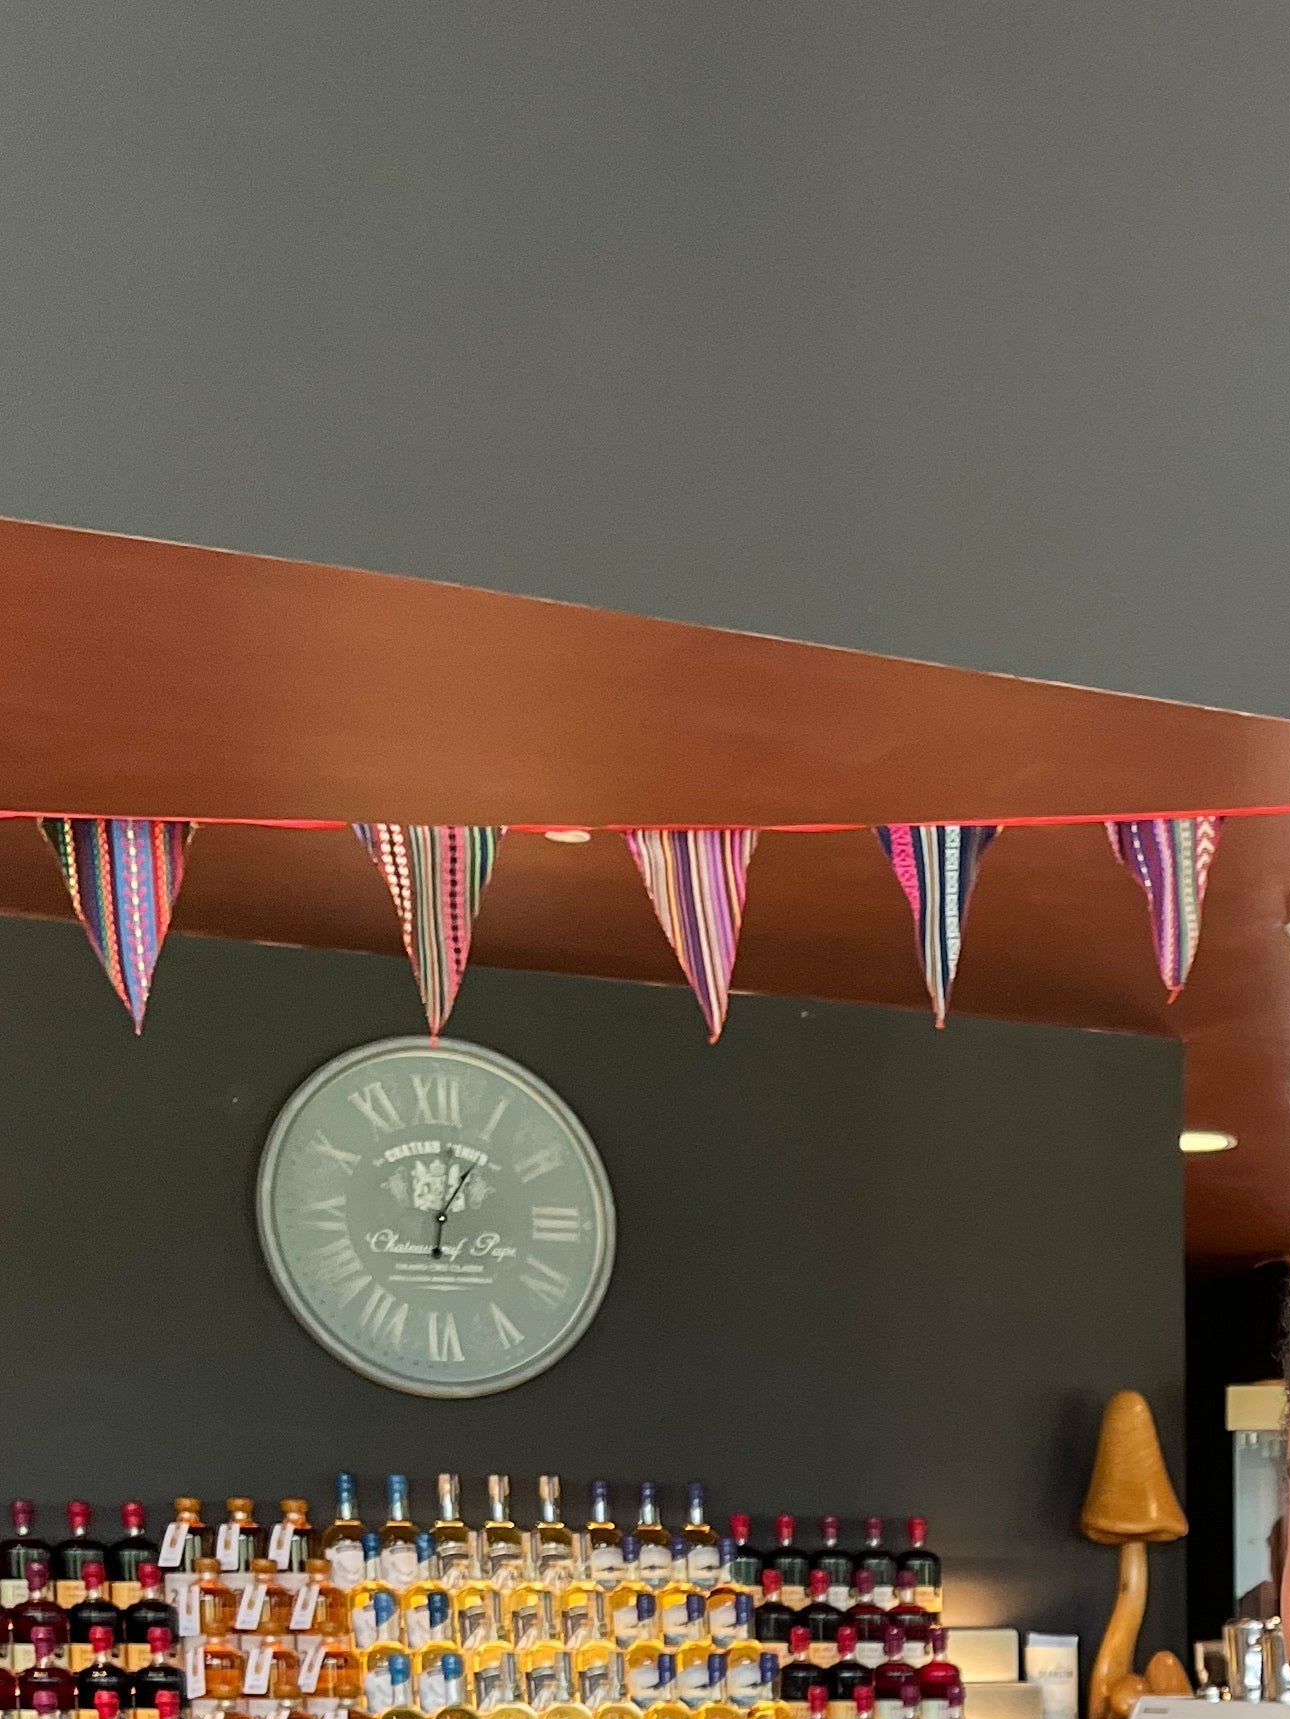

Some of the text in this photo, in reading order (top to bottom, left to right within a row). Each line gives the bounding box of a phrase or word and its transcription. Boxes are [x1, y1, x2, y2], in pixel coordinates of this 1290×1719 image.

[347, 1081, 407, 1142] XI
[411, 1073, 462, 1129] XII
[532, 1206, 580, 1242] III
[428, 1312, 466, 1362] VI
